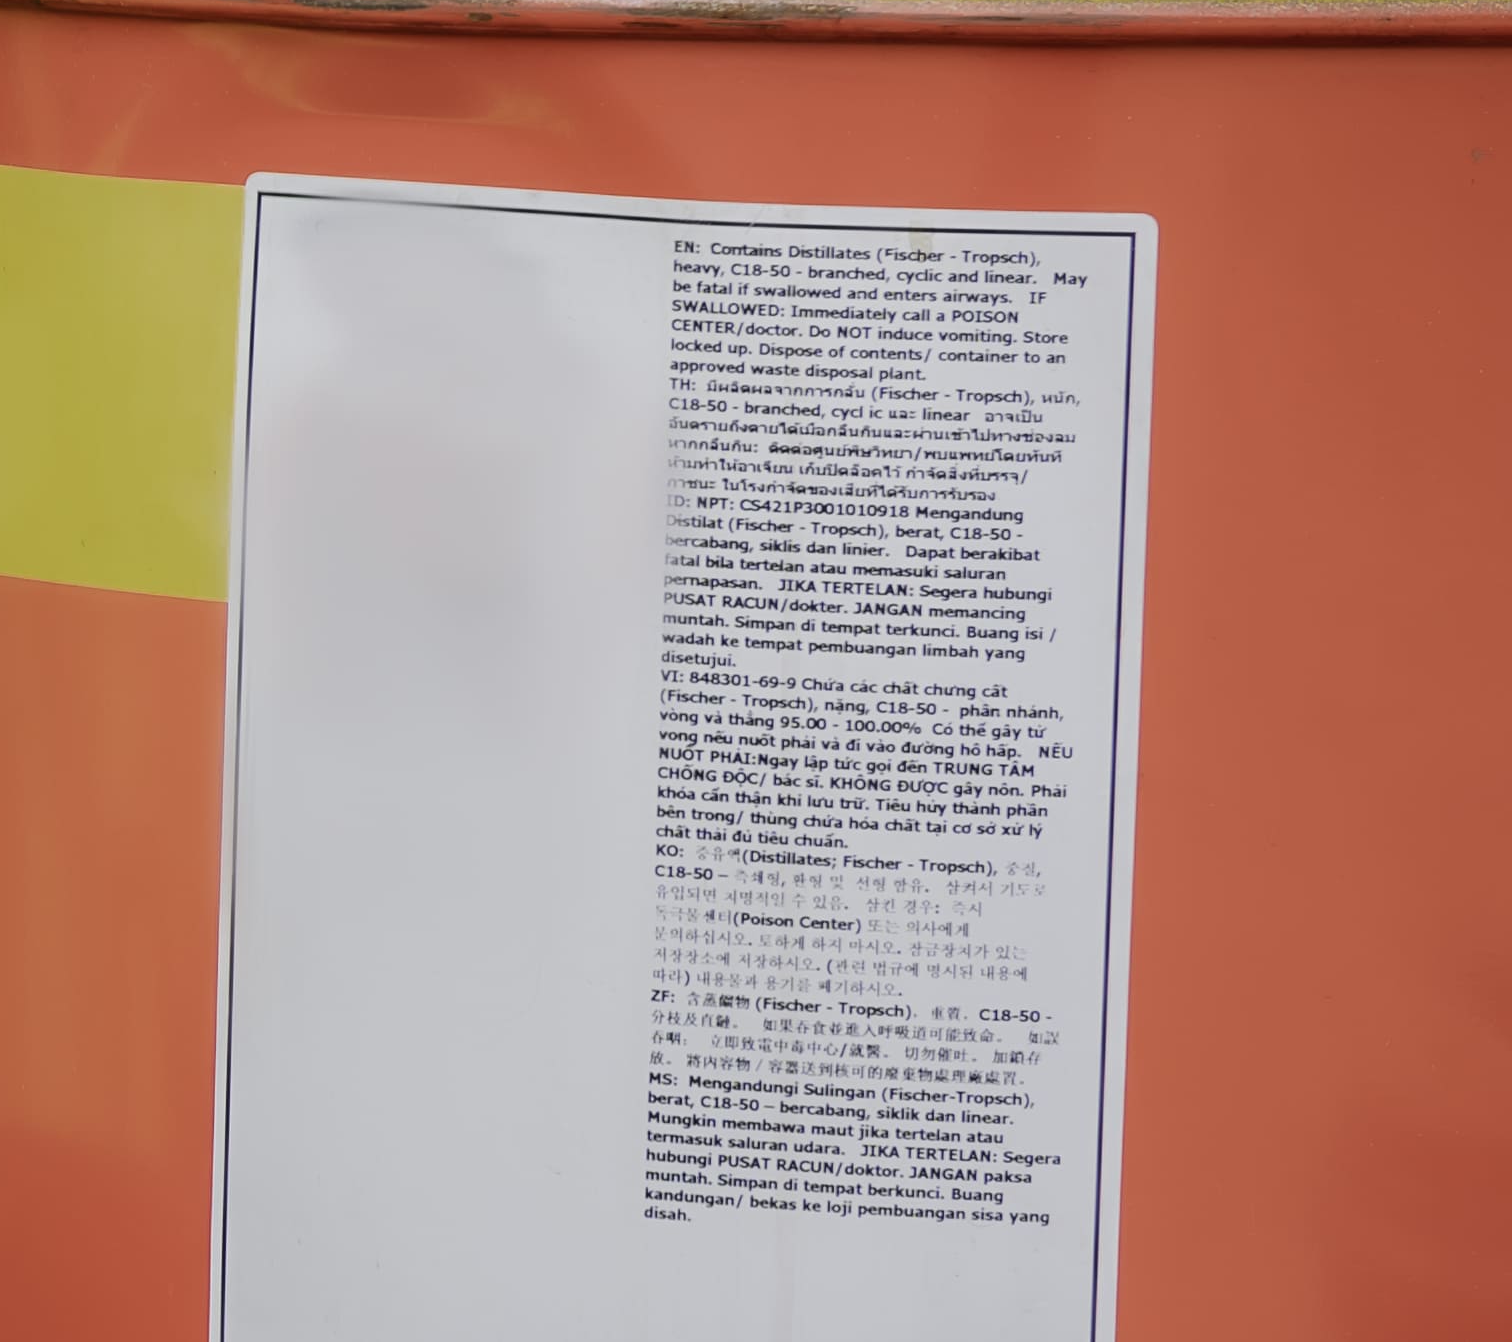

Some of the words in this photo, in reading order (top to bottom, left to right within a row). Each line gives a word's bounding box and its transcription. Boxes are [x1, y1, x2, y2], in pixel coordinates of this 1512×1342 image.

[673, 239, 700, 254] EN:
[710, 242, 782, 257] Contains
[788, 244, 871, 260] Distillates
[961, 249, 1040, 268] Tropsch),
[673, 258, 724, 278] heavy,
[730, 262, 791, 278] C18-50
[807, 265, 890, 283] branched,
[896, 268, 943, 285] cyclic
[947, 269, 979, 283] and
[984, 269, 1037, 285] linear.
[1053, 271, 1088, 289] May
[672, 278, 692, 293] be
[696, 280, 732, 295] fatal
[737, 282, 749, 296] if
[753, 284, 841, 299] swallowed
[846, 287, 878, 300] and
[883, 288, 938, 302] enters
[942, 288, 1012, 307] airways.
[1029, 291, 1047, 304] IF
[671, 298, 784, 317] SWALLOWED:
[790, 304, 897, 324] Immediately
[901, 308, 930, 322] call
[935, 311, 945, 322] a
[951, 309, 1019, 323] POISON
[671, 318, 803, 337] CENTER/doctor.
[808, 324, 831, 338] Do
[836, 325, 872, 339] NOT
[877, 325, 933, 341] induce
[938, 328, 1017, 346] vomiting.
[1022, 330, 1068, 344] Store
[670, 337, 722, 353] locked
[727, 344, 752, 358] up.
[759, 342, 823, 360] Dispose
[827, 345, 846, 358] of
[849, 347, 932, 363] contents/
[937, 348, 1019, 363] container
[1023, 350, 1040, 363] to
[1045, 353, 1066, 364] an
[669, 360, 745, 375] approved
[750, 363, 800, 377] waste
[804, 363, 873, 383] disposal
[668, 376, 696, 391] TH:
[871, 385, 940, 403] (Fischer
[955, 388, 1035, 407] Tropsch),
[668, 396, 727, 413] C18-50
[744, 400, 825, 419] branched,
[922, 406, 971, 422] linear
[697, 496, 734, 510] NPT:
[915, 505, 1024, 525] Mengandung
[728, 516, 794, 534] (Fischer
[810, 521, 889, 540] Tropsch),
[949, 526, 1011, 541] C18-50
[759, 538, 801, 553] siklis
[805, 540, 836, 555] dan
[842, 541, 890, 557] linier.
[905, 544, 955, 562] Dapat
[960, 546, 1040, 562] berakibat
[705, 554, 734, 569] bila
[739, 557, 804, 573] tertelan
[809, 561, 847, 575] atau
[852, 564, 938, 578] memasuki
[943, 566, 1006, 581] saluran
[777, 578, 817, 593] JIKA
[820, 580, 914, 597] TERTELAN:
[919, 584, 977, 601] Segera
[983, 586, 1052, 604] hubungi
[663, 591, 716, 607] PUSAT
[721, 595, 848, 614] RACUN/dokter.
[852, 601, 922, 617] JANGAN
[928, 605, 1026, 624] memancing
[662, 613, 729, 627] muntah.
[734, 615, 795, 633] Simpan
[800, 618, 815, 632] di
[821, 620, 880, 637] tempat
[885, 622, 960, 638] terkunci.
[966, 625, 1019, 643] Buang
[1024, 626, 1043, 641] isi
[661, 631, 715, 646] wadah
[720, 633, 739, 648] ke
[744, 636, 803, 653] tempat
[808, 640, 916, 659] pembuangan
[922, 642, 979, 658] limbah
[984, 648, 1025, 663] yang
[661, 649, 736, 669] disetujui.
[660, 668, 684, 683] VI:
[689, 671, 796, 689] 848301-69-9
[660, 687, 726, 705] (Fischer
[741, 693, 818, 713] Tropsch),
[875, 700, 936, 716] C18-50
[779, 715, 827, 730] 95.00
[845, 719, 922, 735] 100.00%
[932, 761, 993, 776] TRUNG
[776, 792, 802, 807] khi
[654, 864, 713, 880] C18-50
[655, 843, 684, 858] KO:
[843, 854, 903, 870] Fischer
[918, 858, 997, 877] Tropsch),
[799, 916, 862, 933] Center)
[650, 988, 675, 1003] ZF:
[755, 996, 832, 1013] (Fischer
[978, 1008, 1040, 1023] C18-50
[648, 1071, 678, 1087] MS:
[688, 1074, 798, 1098] Mengandungi
[803, 1082, 875, 1101] Sulingan
[647, 1090, 694, 1109] berat,
[700, 1095, 759, 1111] C18-50
[779, 1100, 870, 1121] bercabang,
[876, 1105, 920, 1121] siklik
[924, 1108, 955, 1123] dan
[961, 1109, 1014, 1125] linear.
[647, 1109, 716, 1129] Mungkin
[721, 1118, 805, 1134] membawa
[810, 1124, 854, 1137] maut
[857, 1123, 889, 1141] jika
[895, 1127, 960, 1142] tertelan
[965, 1131, 1003, 1144] atau
[646, 1129, 722, 1147] termasuk
[727, 1136, 788, 1152] saluran
[793, 1140, 845, 1155] udara.
[859, 1143, 900, 1159] JIKA
[904, 1146, 997, 1163] TERTELAN:
[1002, 1150, 1061, 1168] Segera
[645, 1147, 712, 1169] hubungi
[717, 1154, 771, 1170] PUSAT
[776, 1158, 904, 1178] RACUN/doktor.
[908, 1165, 977, 1181] JANGAN
[983, 1169, 1032, 1185] paksa
[645, 1170, 712, 1186] muntah.
[717, 1172, 778, 1192] Simpan
[783, 1177, 798, 1191] di
[803, 1179, 862, 1197] tempat
[867, 1182, 944, 1200] berkunci.
[951, 1187, 1004, 1205] Buang
[643, 1205, 691, 1222] disah.
[644, 1186, 743, 1209] kandungan/
[749, 1194, 797, 1211] bekas
[802, 1197, 821, 1213] ke
[826, 1199, 852, 1217] loji
[857, 1203, 966, 1223] pembuangan
[971, 1206, 1003, 1222] sisa
[1009, 1211, 1050, 1227] yang
